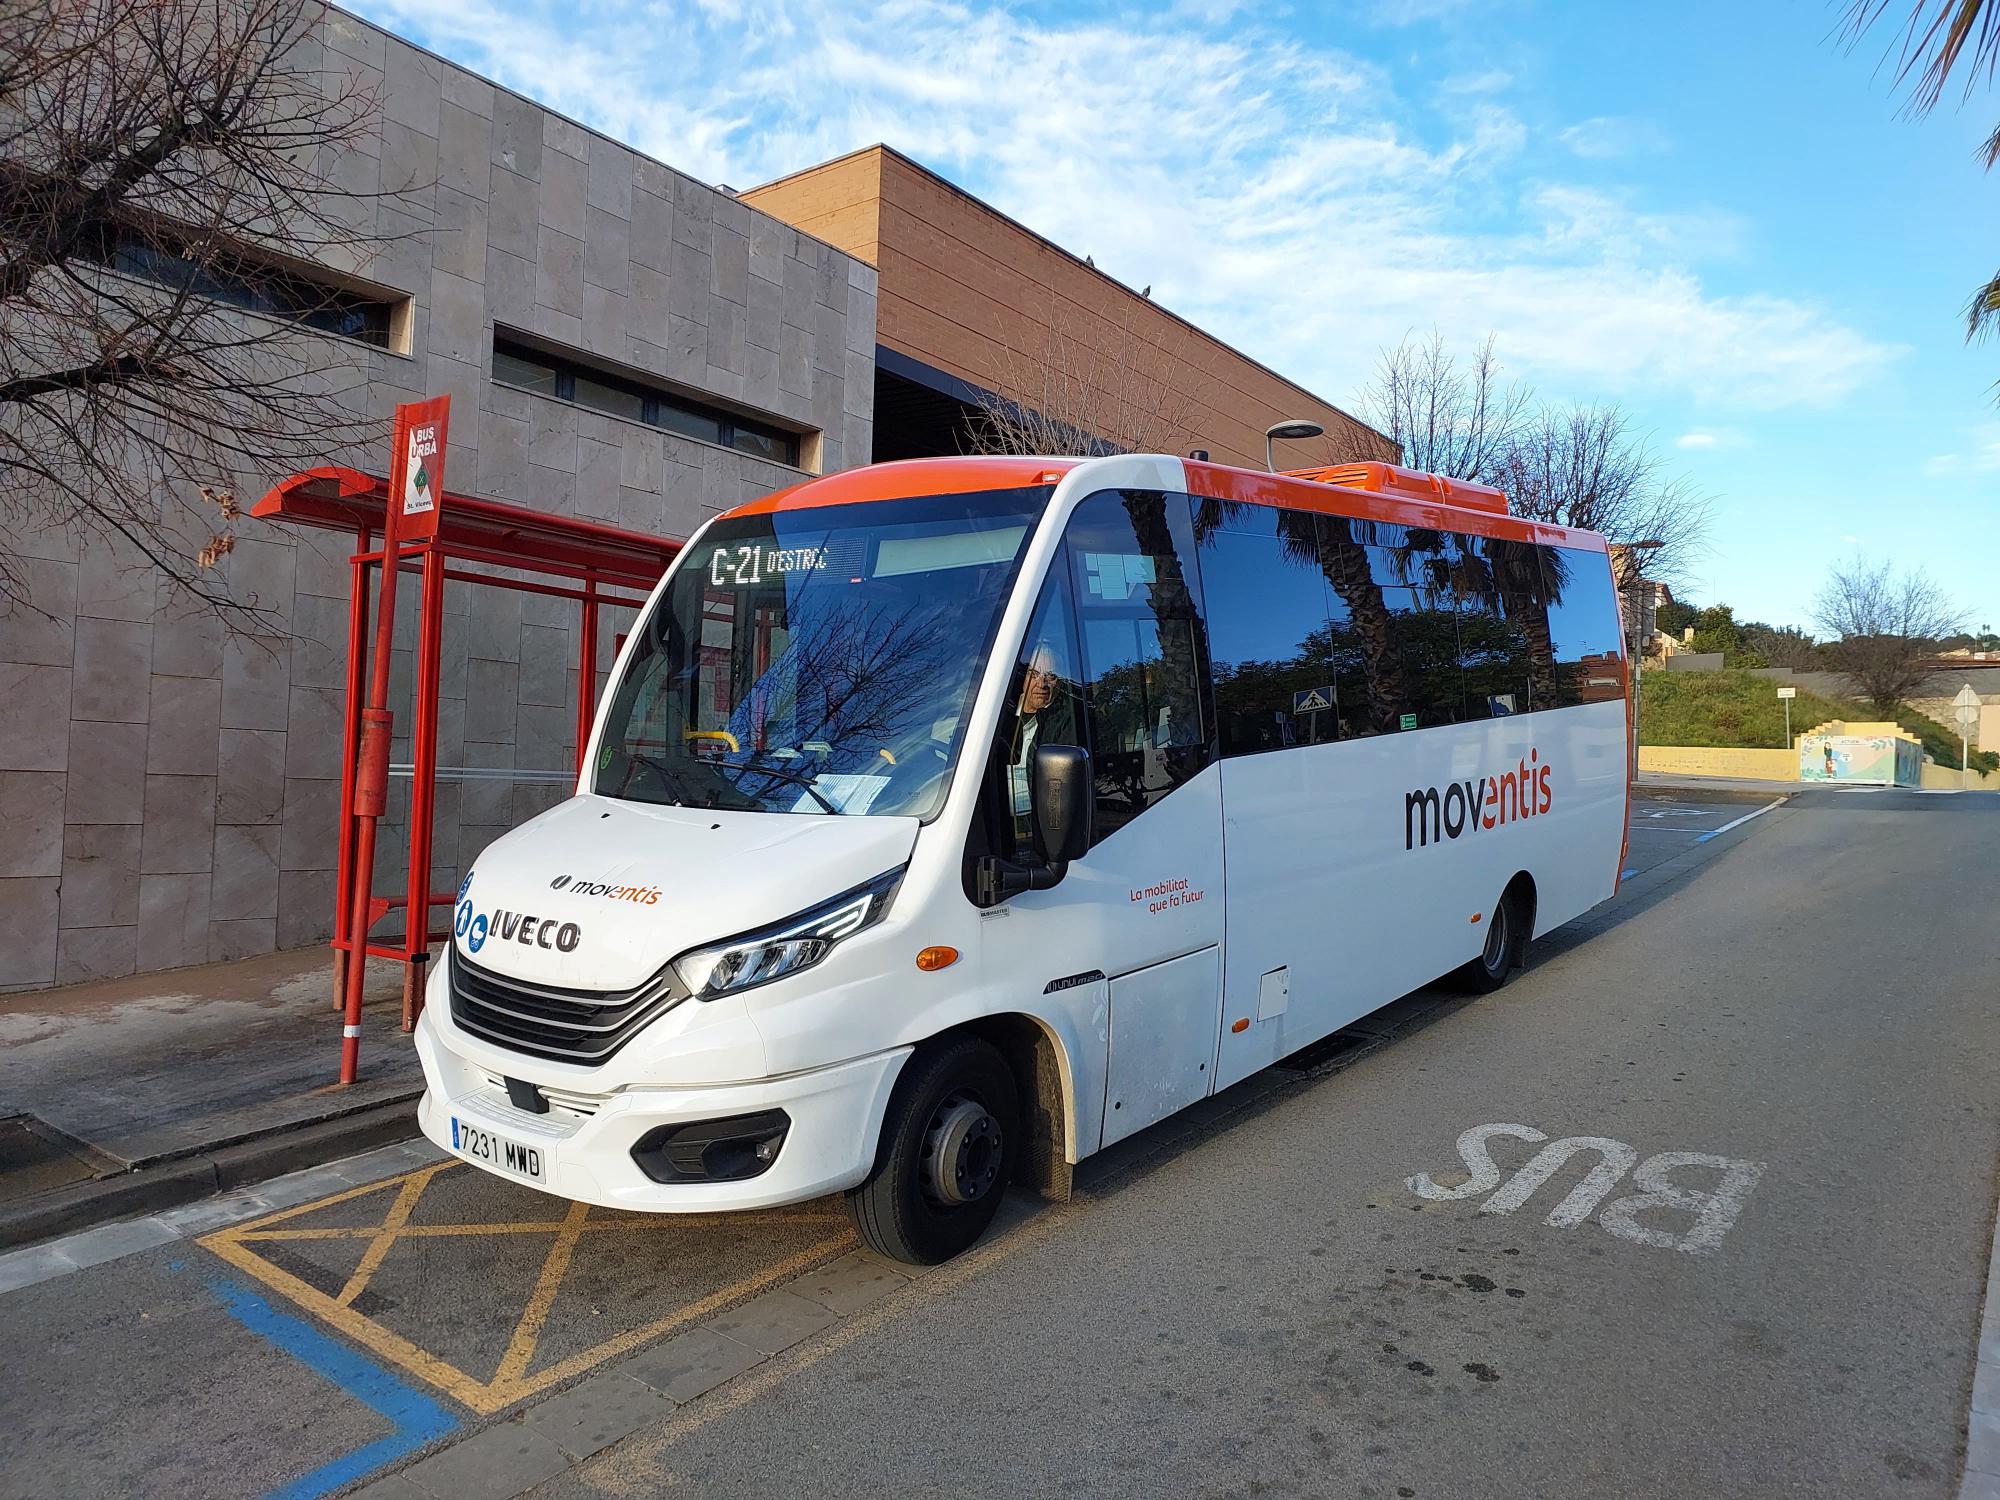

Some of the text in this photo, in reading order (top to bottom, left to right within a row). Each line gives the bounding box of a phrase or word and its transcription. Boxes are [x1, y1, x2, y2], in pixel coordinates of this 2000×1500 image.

[411, 437, 437, 458] URBÀ
[417, 426, 435, 443] BUS
[711, 545, 761, 586] C-21
[1405, 747, 1551, 850] moventis
[569, 879, 663, 905] moventis
[1130, 877, 1189, 902] La mobilitat
[1149, 890, 1205, 915] que fa futur
[489, 908, 582, 953] IVECO
[461, 1124, 540, 1177] 7231 MWD
[1403, 1122, 1768, 1256] BUS
